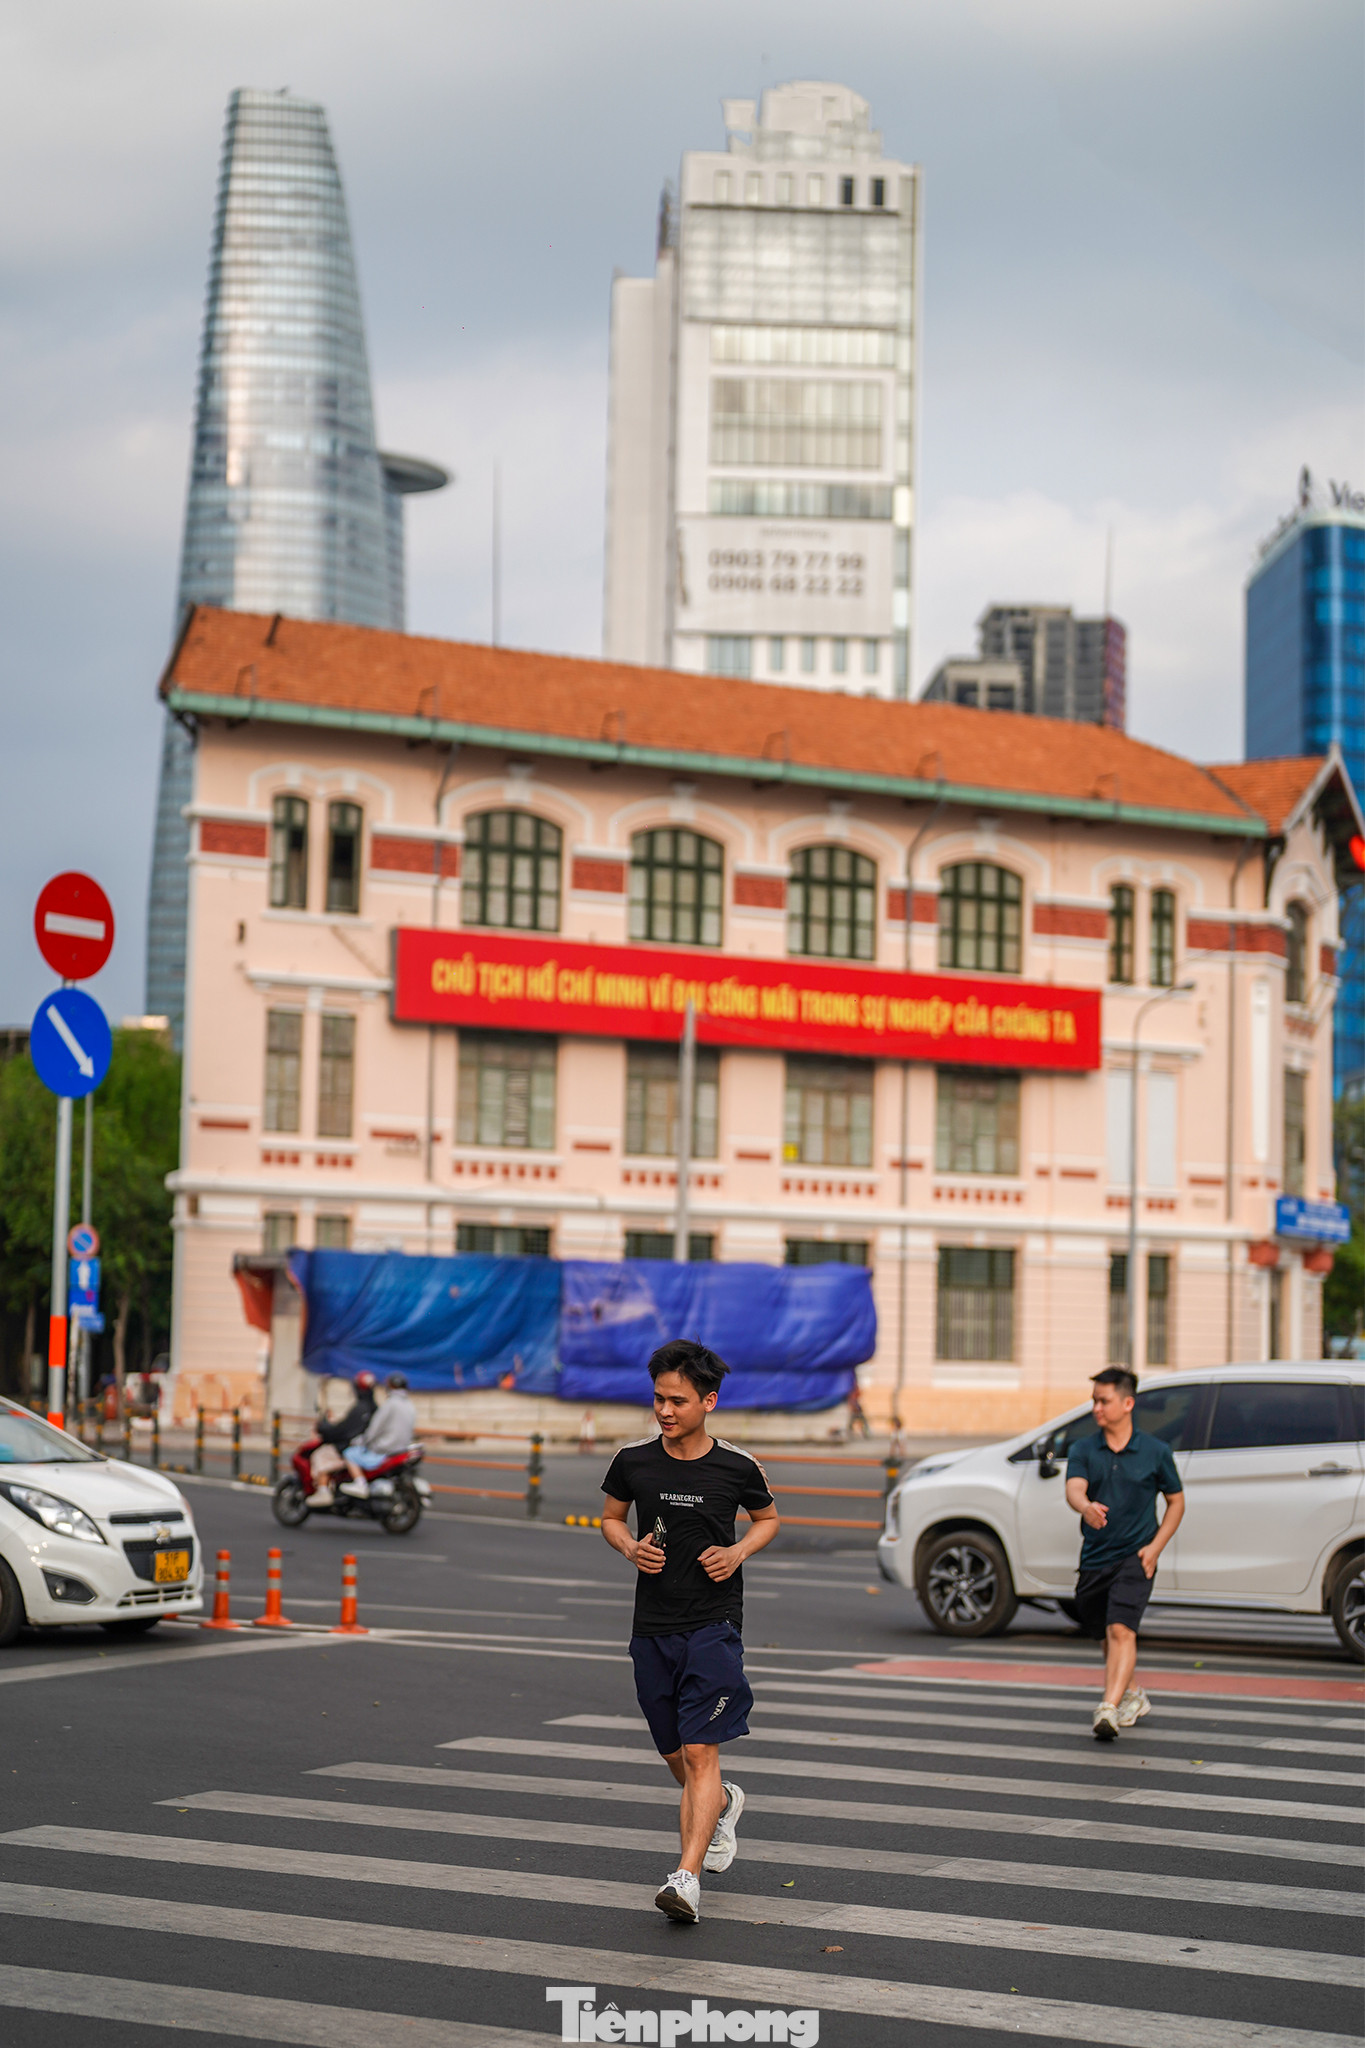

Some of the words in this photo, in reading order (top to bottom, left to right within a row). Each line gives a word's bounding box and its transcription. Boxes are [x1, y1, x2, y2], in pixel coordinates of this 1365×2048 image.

[708, 549, 765, 569] 0903
[770, 549, 799, 570] 79
[803, 550, 830, 571] 77
[708, 571, 765, 592] 0906
[803, 573, 830, 595] 22
[836, 574, 865, 596] 22
[432, 952, 476, 996] CHỦ
[477, 961, 525, 1003] TỊCH
[526, 959, 557, 1003] HỒ
[558, 965, 594, 1005] CHÍ
[594, 971, 648, 1010] MINH
[650, 973, 673, 1012] VĨ
[708, 975, 759, 1019] SỐNG
[760, 982, 799, 1022] MÃI
[800, 989, 860, 1027] TRONG
[861, 995, 887, 1035] SỰ
[888, 996, 952, 1039] NGHIỆP
[953, 995, 990, 1037] CỦA
[992, 1001, 1050, 1042] CHÚNG
[1052, 1010, 1077, 1043] TA
[710, 1696, 730, 1721] VANS
